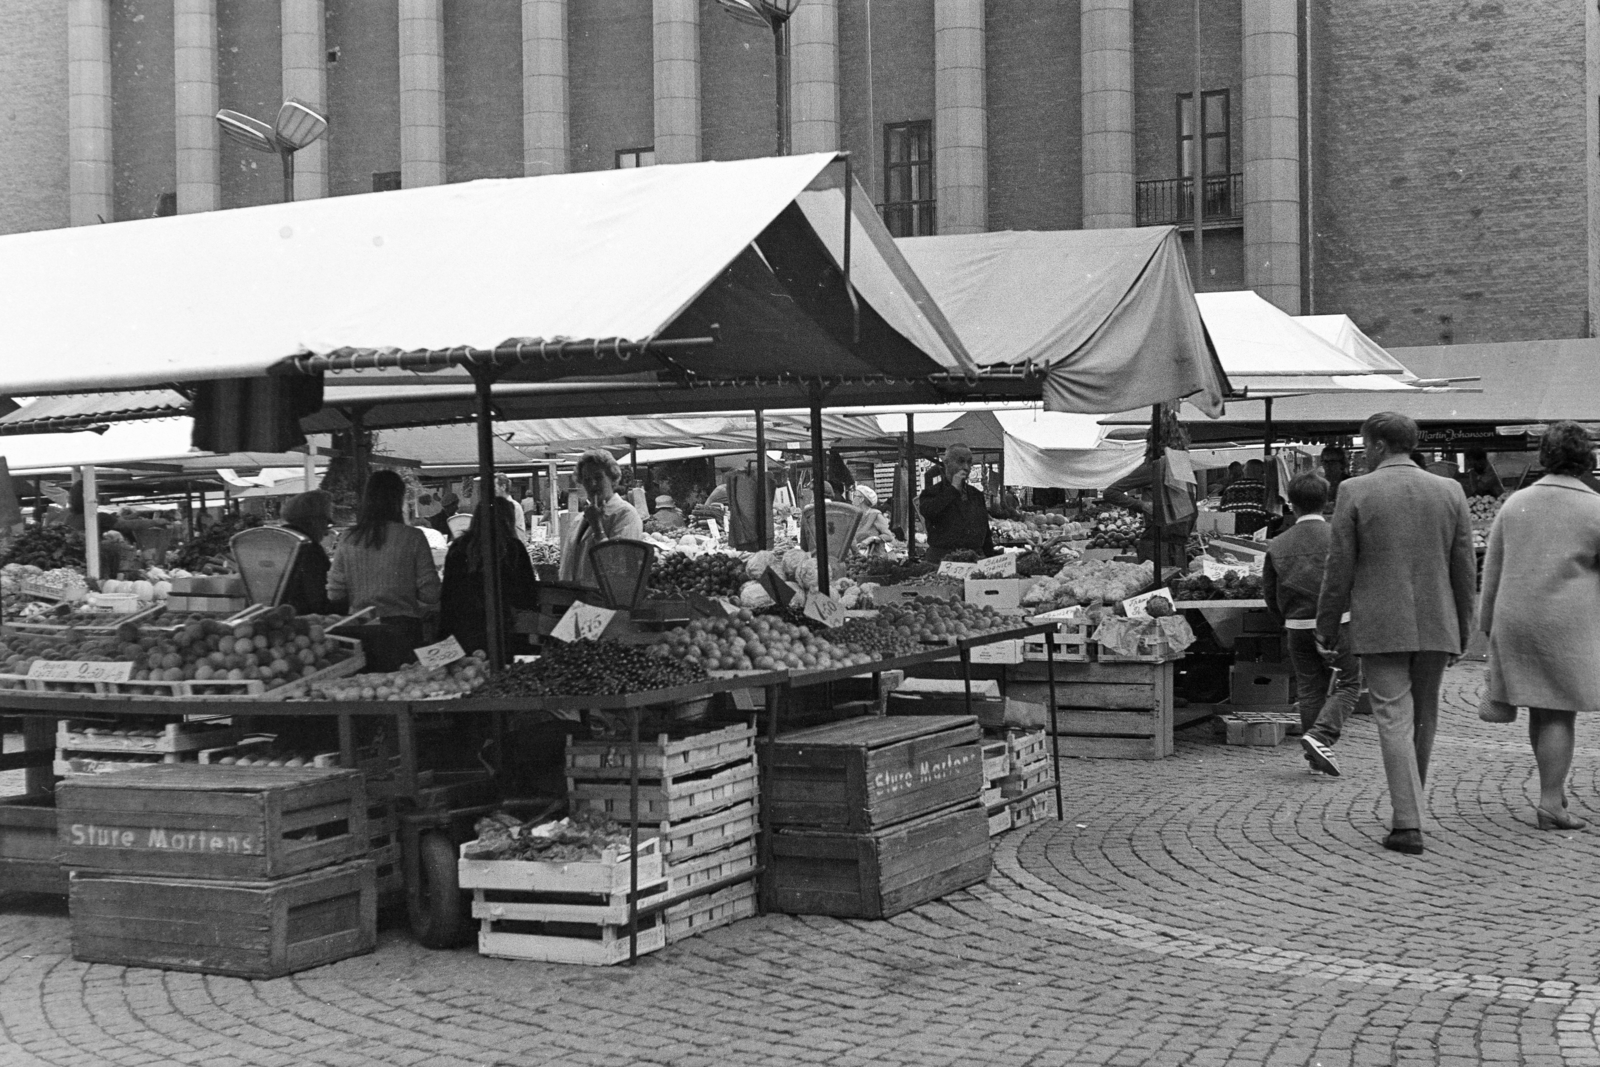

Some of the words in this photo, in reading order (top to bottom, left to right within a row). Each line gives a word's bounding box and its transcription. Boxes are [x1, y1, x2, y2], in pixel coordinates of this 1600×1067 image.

[1417, 430, 1446, 441] Martin
[1445, 429, 1494, 441] Johansson
[875, 770, 913, 795] Sture
[71, 823, 135, 847] Sture
[148, 828, 252, 855] Martens
